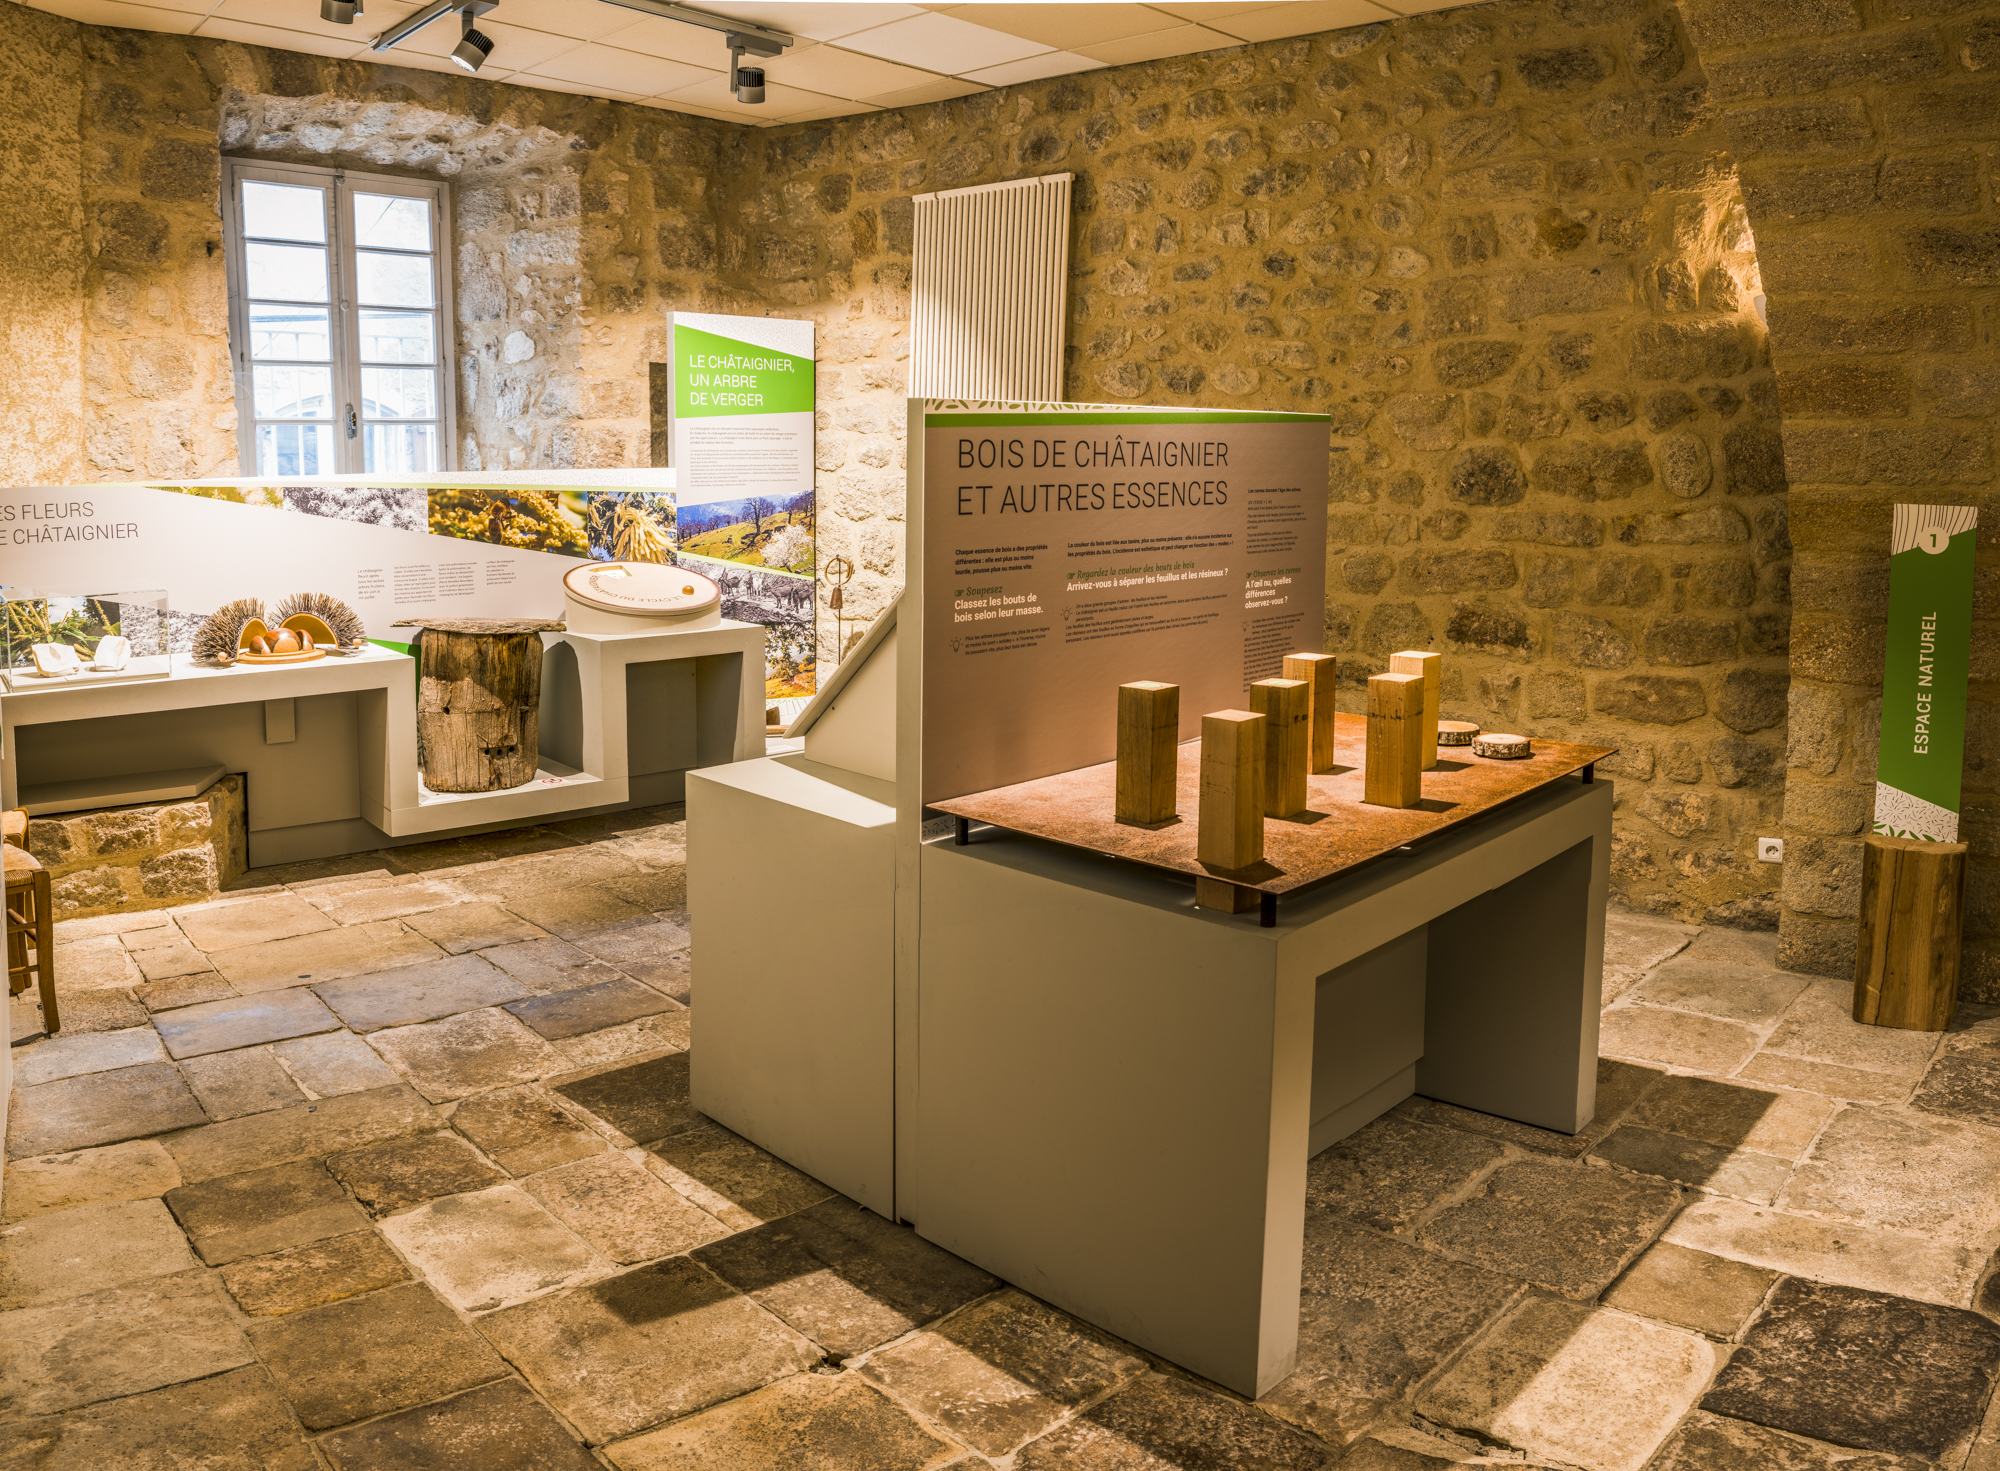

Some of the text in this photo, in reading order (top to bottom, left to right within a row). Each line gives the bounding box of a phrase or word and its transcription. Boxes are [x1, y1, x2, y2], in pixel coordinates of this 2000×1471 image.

[690, 354, 795, 374] LE CHÂTAIGNIER,
[690, 374, 756, 388] UN ARBRE
[690, 392, 763, 406] DE VERGER
[959, 436, 1228, 468] BOIS DE CHÂTAIGNIER
[958, 481, 1227, 515] ET AUTRES ESSENCES
[22, 502, 94, 520] FLEURS
[13, 523, 138, 544] CHÂTAIGNIER
[1929, 533, 1938, 548] 1
[1077, 561, 1195, 581] Regardez la couleur des bouts de bois
[1253, 570, 1276, 578] Observez
[1067, 581, 1112, 591] Arrivez-vous
[1113, 578, 1118, 587] à
[1119, 577, 1144, 587] séparer
[1145, 575, 1155, 584] les
[1157, 573, 1180, 582] feuillus
[1188, 571, 1198, 579] les
[1198, 570, 1223, 578] résineux
[1251, 579, 1263, 588] l'œil
[1273, 577, 1291, 587] quelles
[966, 586, 1003, 597] Soupesez
[1245, 590, 1276, 598] différences
[955, 593, 1037, 610] Classez les bouts de
[1245, 598, 1284, 608] observez-vous
[954, 606, 1044, 622] bois selon leur masse.
[1914, 611, 1937, 754] ESPACE NATUREL
